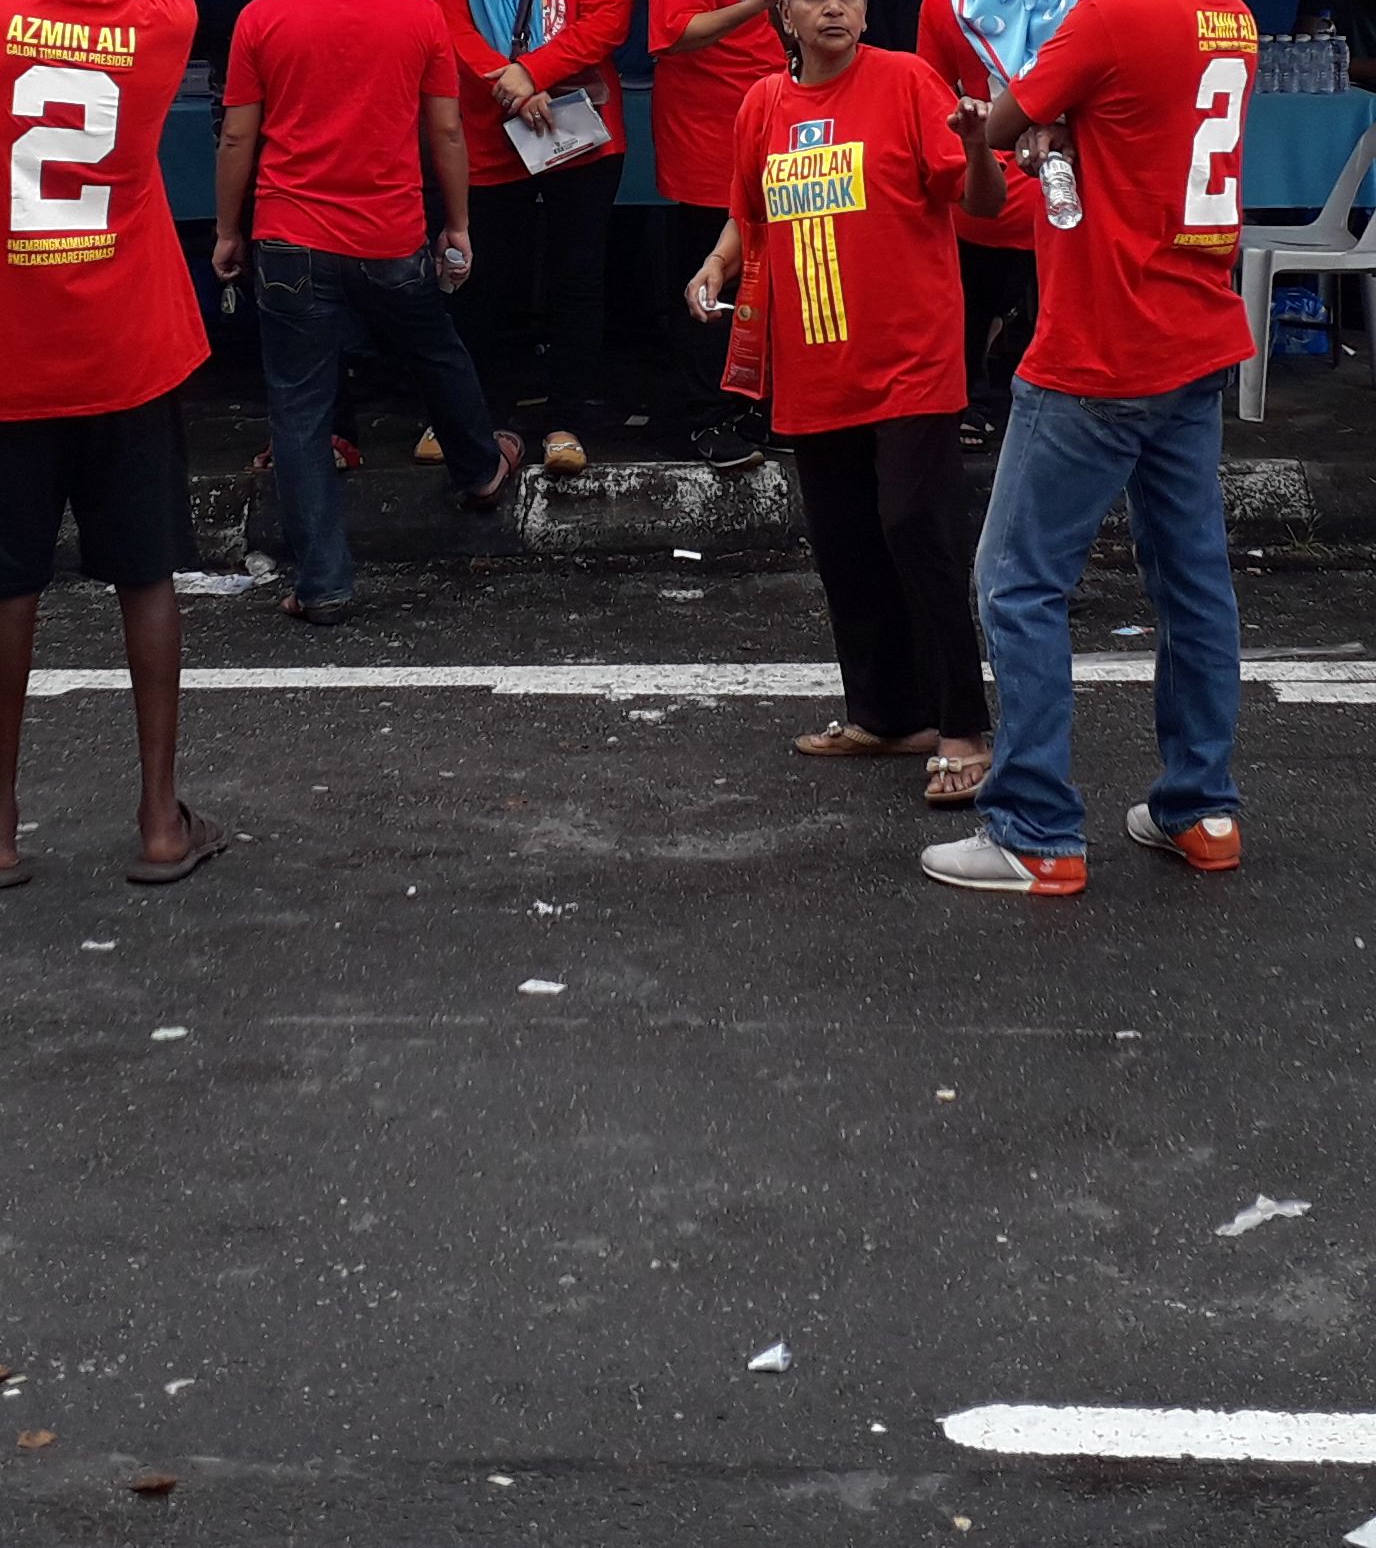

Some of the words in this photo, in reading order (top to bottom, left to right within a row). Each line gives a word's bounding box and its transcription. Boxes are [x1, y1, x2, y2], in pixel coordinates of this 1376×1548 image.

[7, 14, 90, 50] AZMIN
[97, 27, 136, 53] ALI
[1197, 10, 1237, 39] AZMIN
[6, 43, 36, 58] CALON
[39, 47, 86, 63] TIMBALAN
[89, 53, 134, 67] PRESIDEN
[10, 65, 119, 231] 2
[1184, 58, 1248, 226] 2
[766, 148, 852, 185] KEADILAN
[768, 175, 855, 217] GOMBAK
